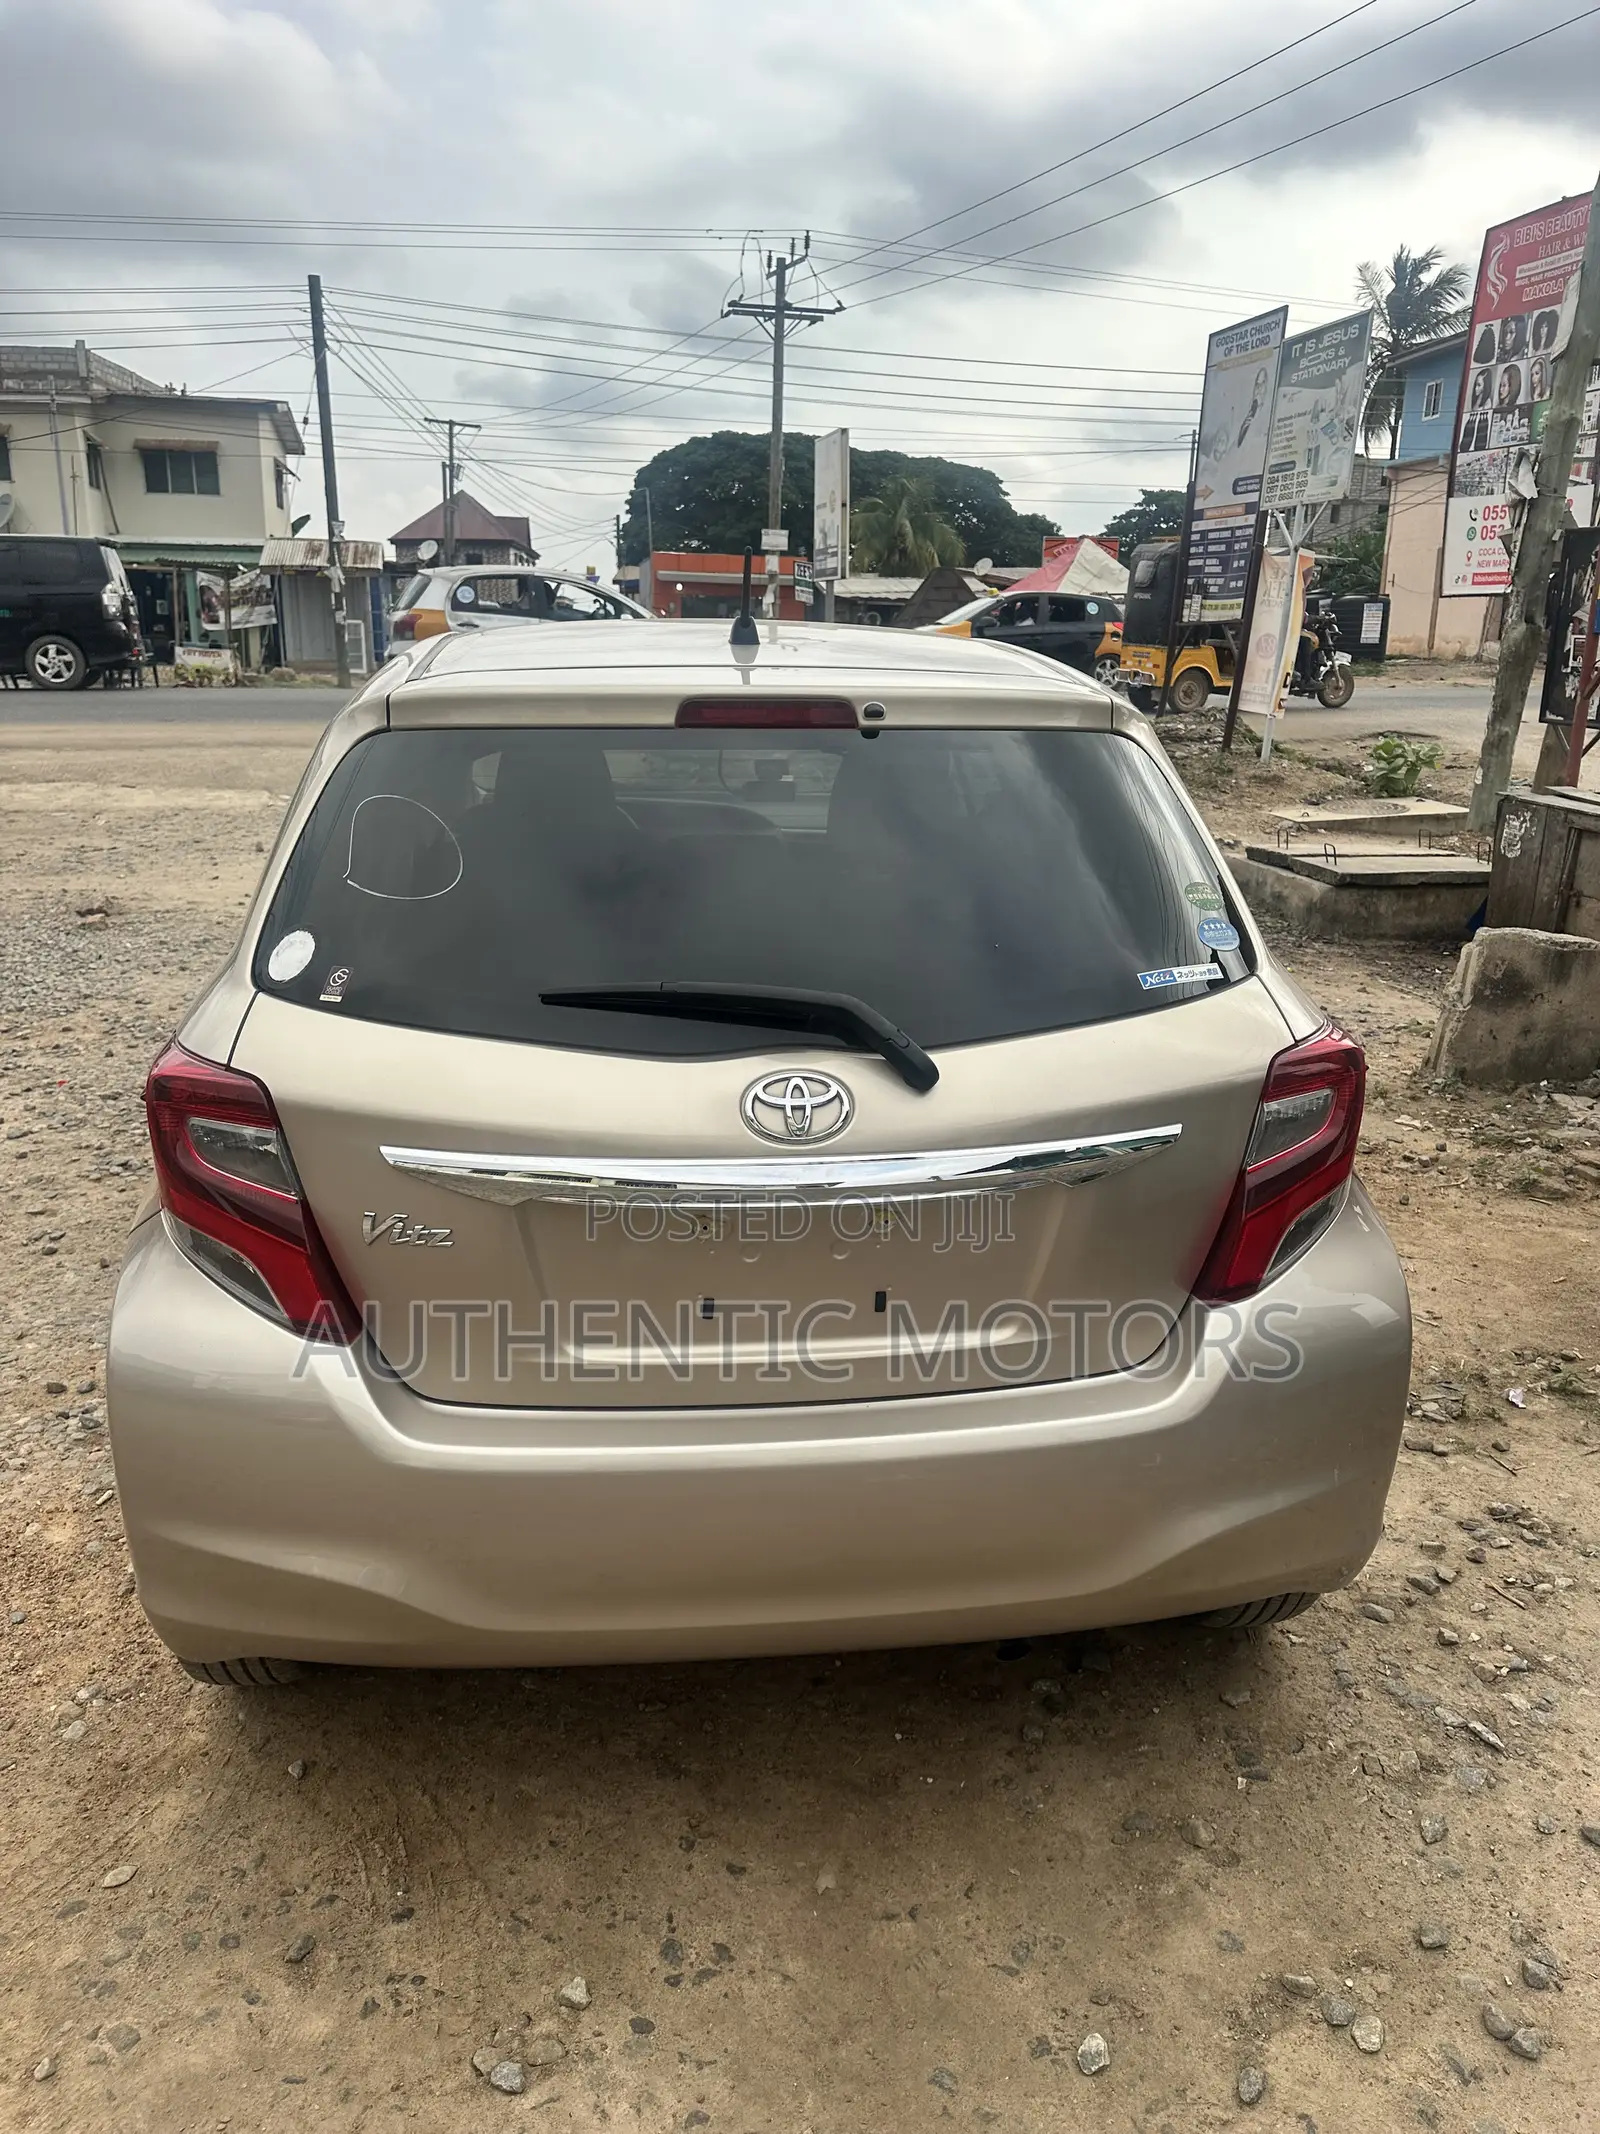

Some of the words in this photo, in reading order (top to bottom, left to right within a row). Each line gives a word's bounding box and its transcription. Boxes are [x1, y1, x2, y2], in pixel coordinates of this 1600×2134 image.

[1545, 205, 1588, 238] BEAUTY
[1538, 240, 1561, 258] HAIR
[1563, 237, 1571, 250] &
[1544, 265, 1572, 279] PRODUCTS
[1522, 278, 1564, 302] MAKOLA
[1216, 329, 1248, 348] GODSTAR
[1249, 318, 1281, 339] CHURCH
[1291, 343, 1303, 358] IT
[1304, 338, 1316, 354] IS
[1318, 323, 1360, 349] JESUS
[1224, 346, 1234, 357] OF
[1235, 340, 1250, 355] THE
[1251, 334, 1271, 351] LORD
[1338, 346, 1345, 356] &
[1290, 356, 1352, 383] STATIONARY
[1482, 504, 1509, 521] 055
[1478, 547, 1496, 556] COCA
[1477, 559, 1491, 568] NEW
[362, 1211, 455, 1247] Vitz
